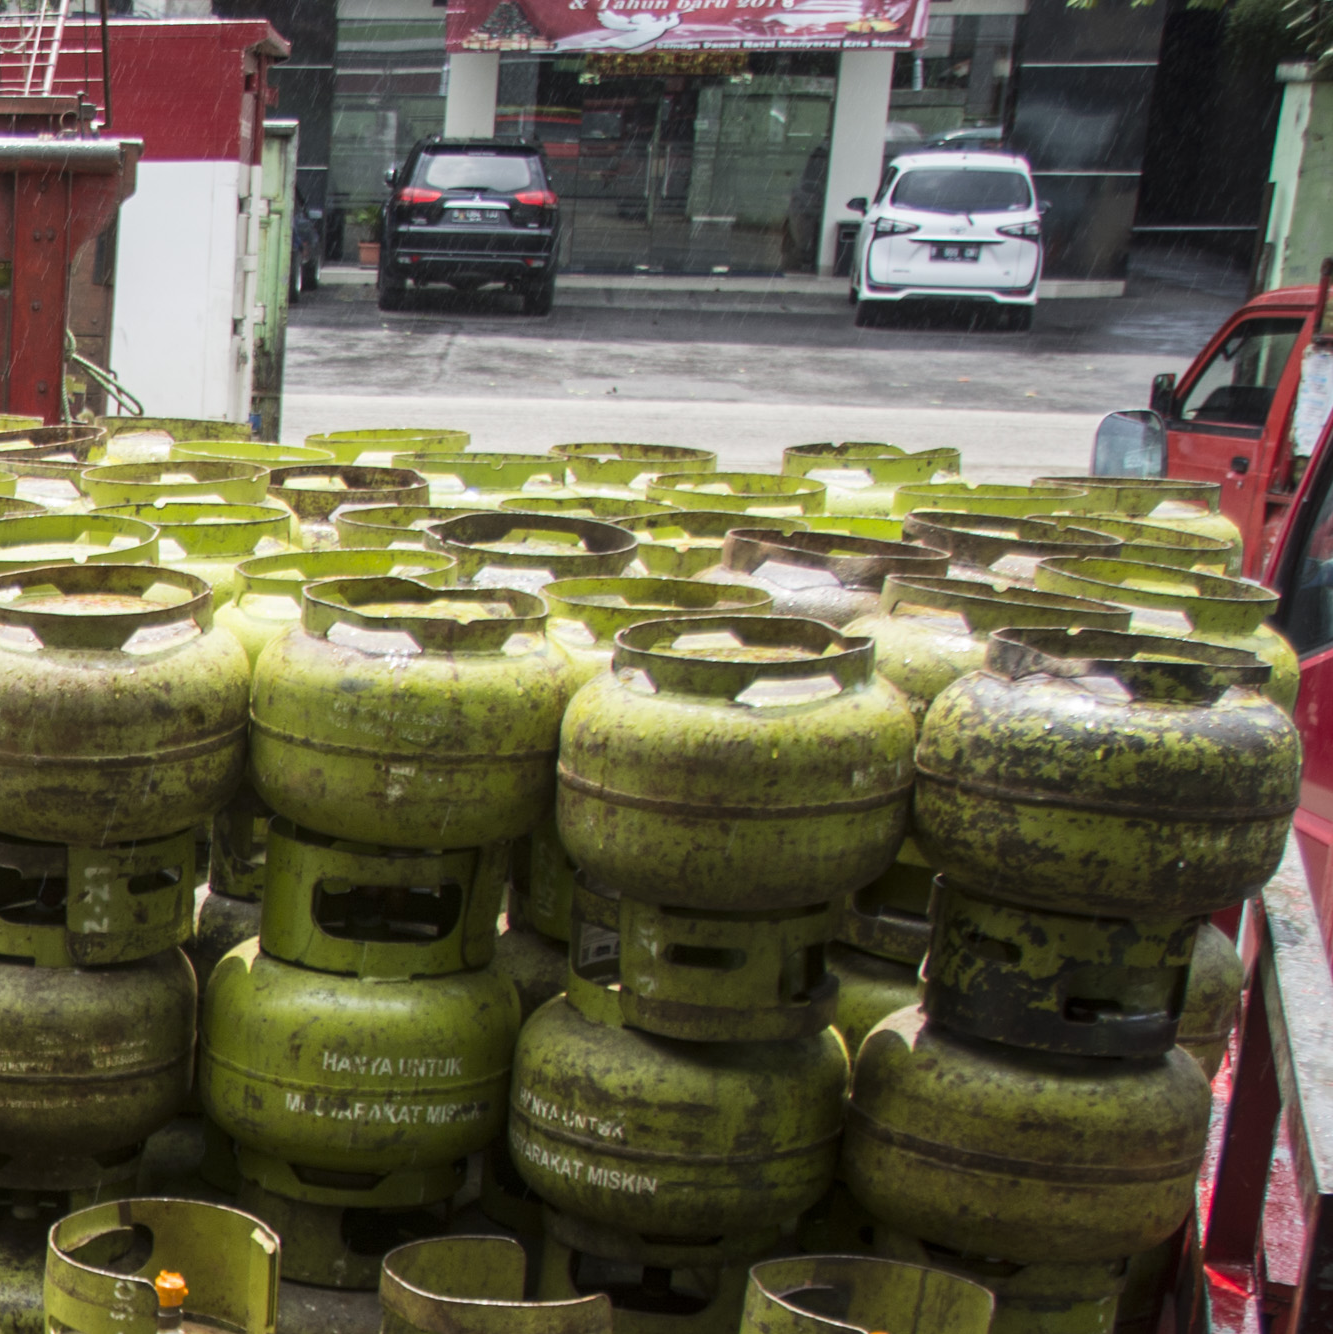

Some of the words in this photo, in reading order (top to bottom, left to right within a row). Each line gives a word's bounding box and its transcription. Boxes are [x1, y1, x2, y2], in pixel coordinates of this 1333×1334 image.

[743, 40, 776, 49] Natal
[871, 40, 911, 48] Semua
[322, 1050, 393, 1076] HANYA
[398, 1057, 463, 1078] UNTUK
[587, 1164, 658, 1195] MISKIN
